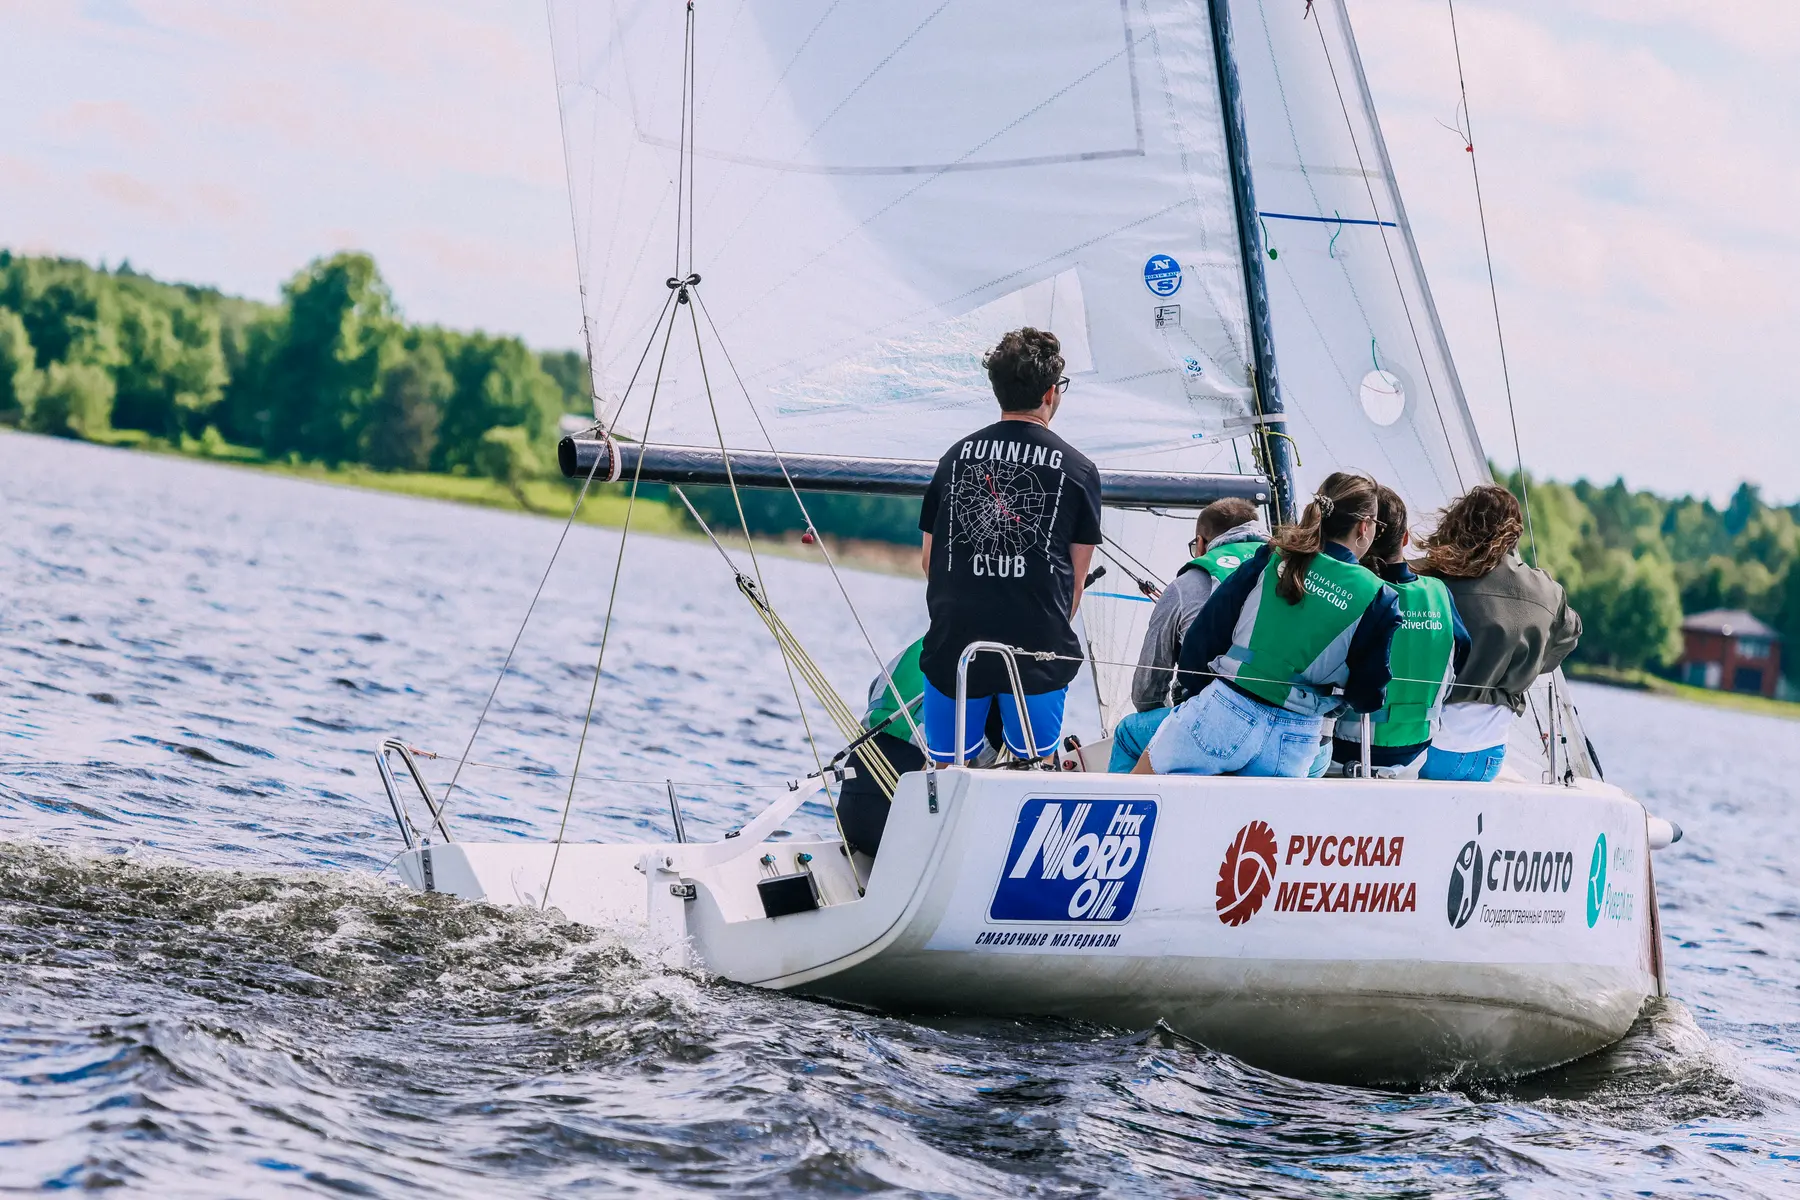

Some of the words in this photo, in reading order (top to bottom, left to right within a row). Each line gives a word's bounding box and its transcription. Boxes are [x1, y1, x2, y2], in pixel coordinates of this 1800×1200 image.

[1152, 259, 1171, 270] N
[1157, 280, 1174, 291] S
[1157, 309, 1163, 318] J
[960, 440, 1063, 470] RUNNING
[973, 554, 1026, 577] CLUB
[1303, 578, 1348, 611] RiverClub
[1307, 570, 1353, 600] КОНАКОВО
[1400, 610, 1441, 618] КОНАКОВО
[1401, 619, 1443, 630] RiverClub
[1008, 803, 1141, 880] NORD
[1285, 835, 1405, 867] РУССКАЯ
[1487, 849, 1573, 893] СТОЛОТО
[1068, 878, 1125, 919] OIL
[1274, 882, 1417, 912] МЕХАНИКА
[1479, 904, 1542, 928] Государственные
[975, 932, 1048, 946] смазочные
[1049, 933, 1121, 949] материалы
